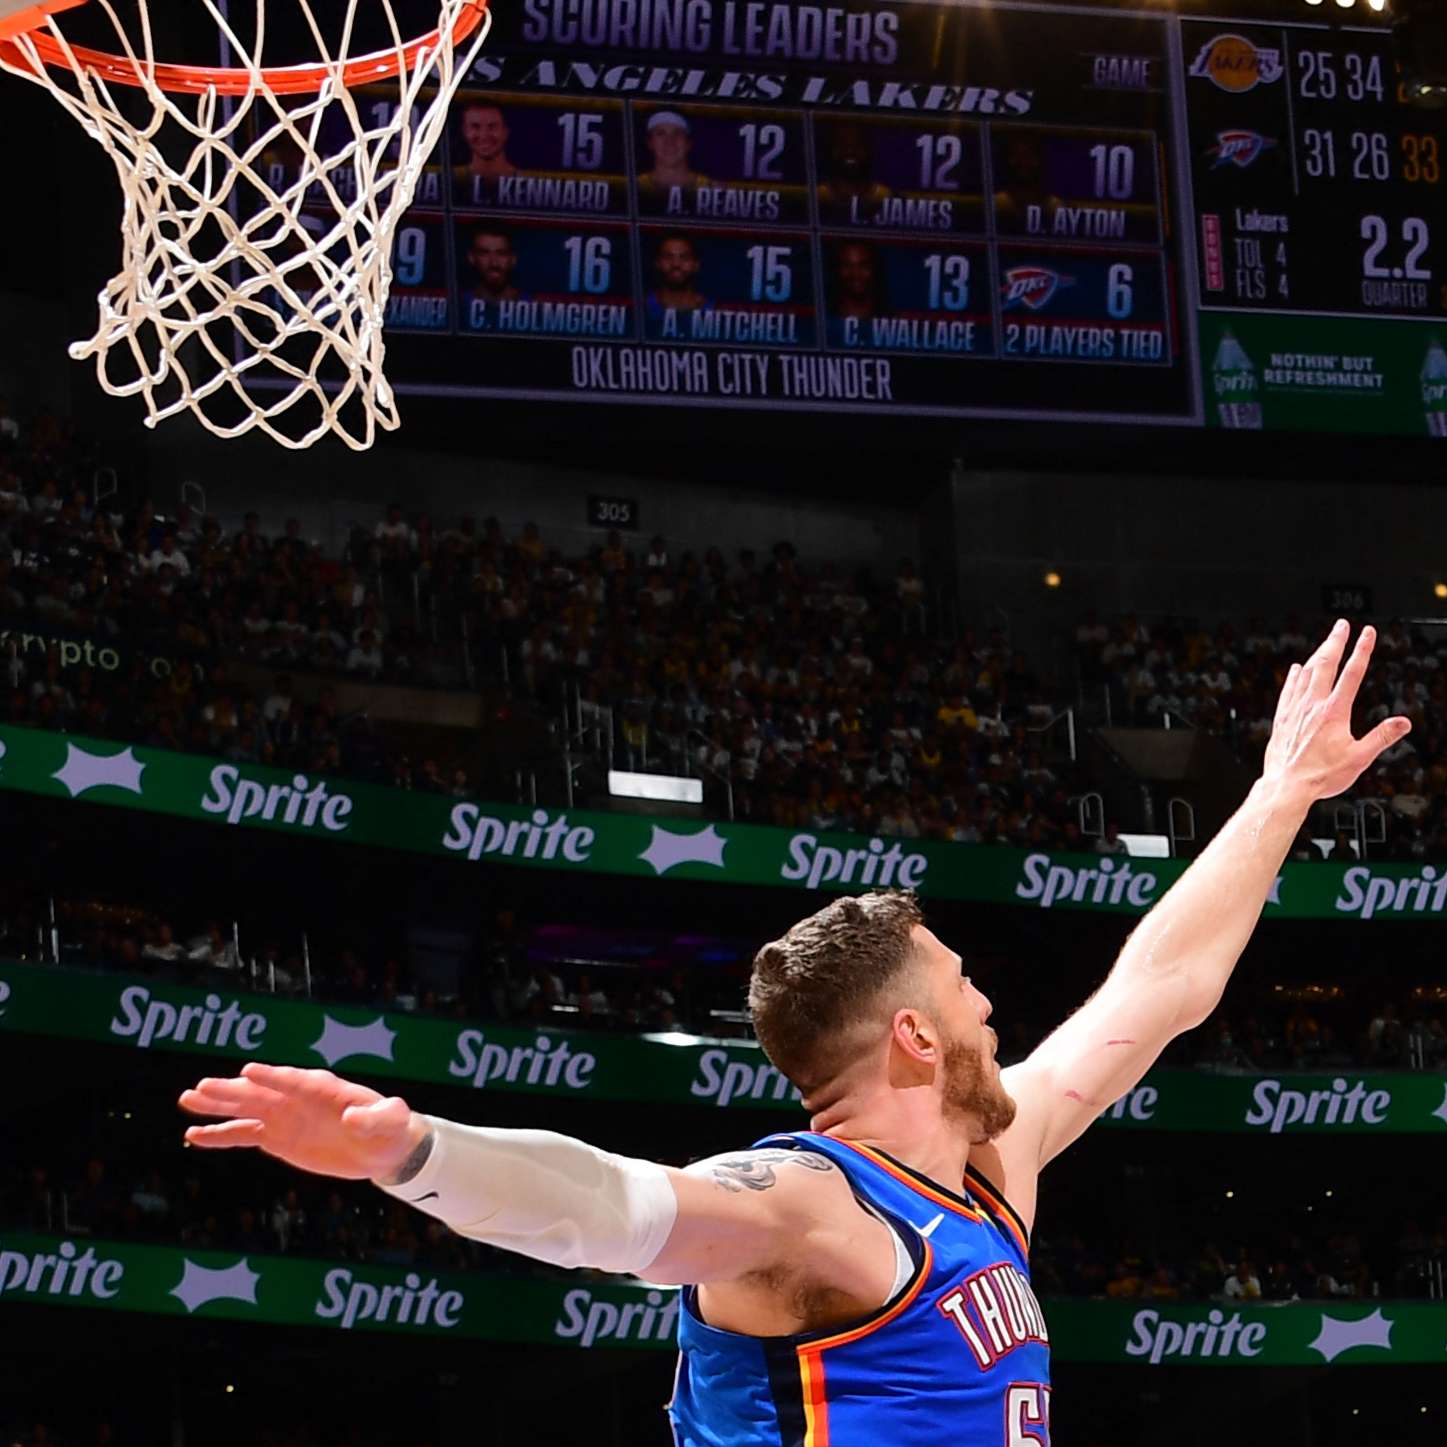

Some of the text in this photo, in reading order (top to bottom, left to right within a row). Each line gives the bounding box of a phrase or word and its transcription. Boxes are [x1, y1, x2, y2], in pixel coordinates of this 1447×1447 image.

[522, 0, 899, 66] SCORING LEADERS
[519, 59, 787, 101] ANGELES
[801, 76, 1035, 116] LAKERS
[1093, 57, 1151, 87] GAME
[1299, 51, 1336, 100] 25
[1346, 54, 1384, 102] 34
[557, 113, 604, 171] 15
[738, 123, 787, 182] 12
[916, 133, 963, 191] 12
[1304, 128, 1336, 178] 31
[1352, 131, 1390, 182] 26
[1401, 135, 1441, 183] 33
[473, 175, 491, 206] L.
[499, 177, 610, 211] KENNARD
[1089, 145, 1136, 200] 10
[667, 187, 780, 220] A. REAVES
[851, 196, 953, 230] L. JAMES
[1026, 205, 1128, 239] D. AYTON
[563, 235, 612, 294] 16
[1235, 208, 1290, 234] Lakers
[1360, 213, 1432, 281] 2.2
[1235, 239, 1287, 268] TOL 4
[746, 244, 794, 303] 15
[923, 253, 972, 312] 13
[1106, 262, 1134, 320] 6
[1235, 269, 1289, 299] FLS 4
[1361, 279, 1429, 309] QUARTER
[469, 299, 492, 330] C.
[499, 300, 628, 337] HOLMGREN
[662, 308, 800, 344] A. MITCHELL
[843, 316, 976, 352] C. WALLACE
[1006, 323, 1164, 360] 2 PLAYERS TIED
[571, 346, 893, 400] OKLAHOMA CITY THUNDER
[1263, 369, 1385, 389] REFRESHMENT
[1270, 352, 1374, 372] NOTHIN' BUT
[597, 502, 631, 523] 305
[202, 765, 351, 829] Sprite
[443, 803, 593, 861] Sprite
[782, 834, 926, 890] Sprite
[1017, 852, 1157, 907] Sprite
[111, 986, 265, 1049] Sprite
[449, 1030, 594, 1087] Sprite
[1246, 1078, 1390, 1132] Sprite
[0, 1241, 123, 1298] prite
[316, 1269, 462, 1328] Sprite
[556, 1289, 678, 1349] Sprit
[1126, 1310, 1265, 1363] Sprite
